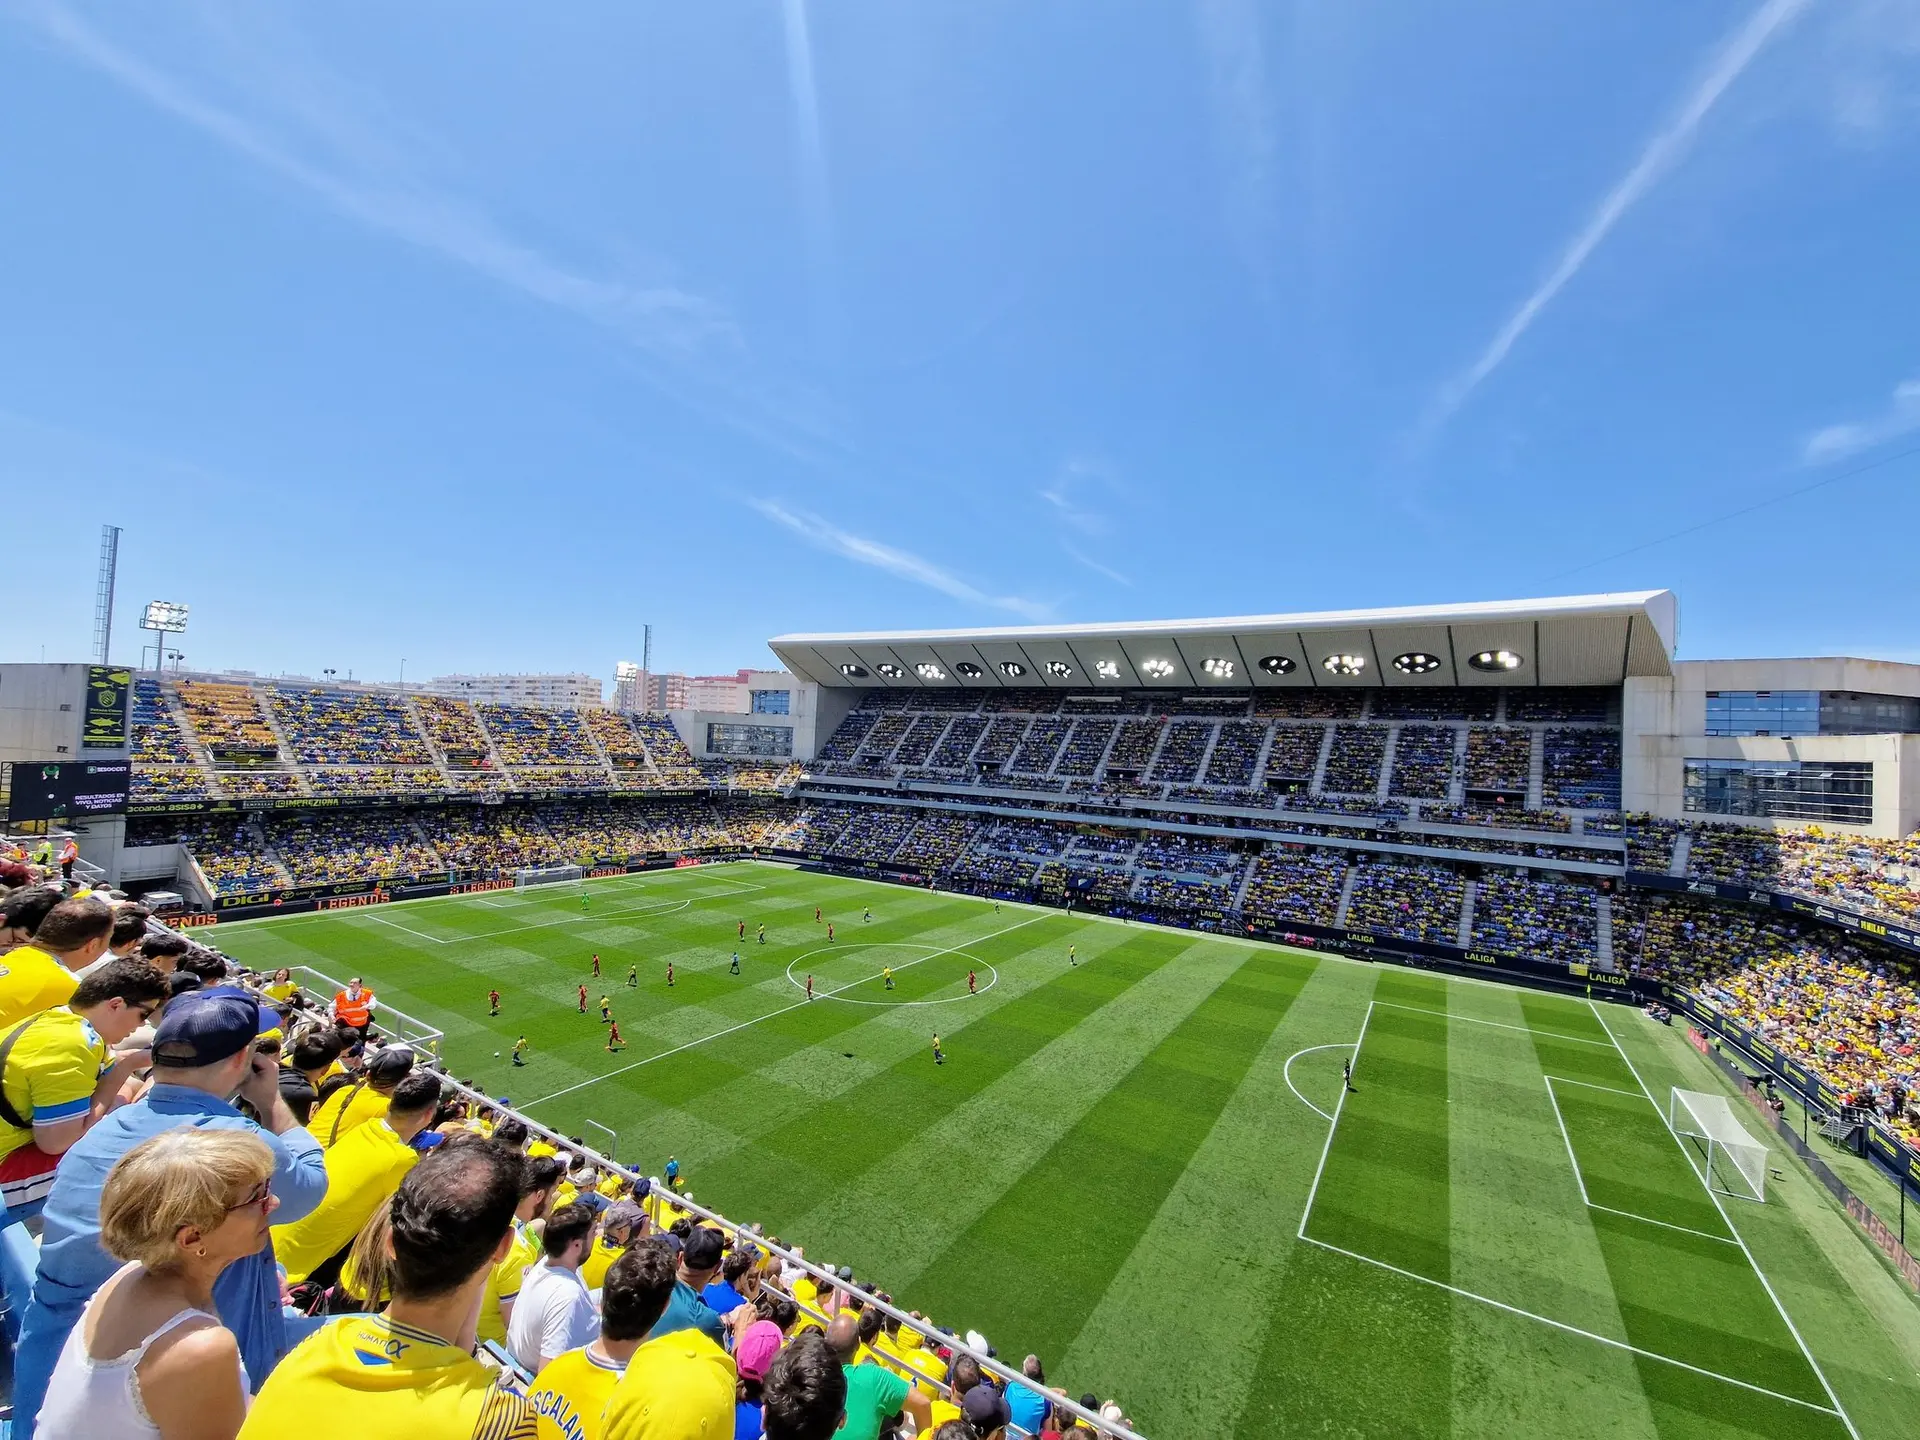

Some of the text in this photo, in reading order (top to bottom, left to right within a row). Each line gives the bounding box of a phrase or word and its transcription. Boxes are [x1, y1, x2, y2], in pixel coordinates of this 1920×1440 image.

[583, 866, 627, 879] LEGENDS
[462, 879, 514, 894] LEGENDS
[223, 893, 269, 907] DIGI
[316, 892, 391, 911] LEGENDS
[1200, 909, 1223, 919] LALIGA
[1347, 933, 1375, 943] LALIGA
[1464, 952, 1496, 964] LALIGA
[1589, 972, 1626, 986] LALIGA
[529, 1390, 585, 1440] SCALA
